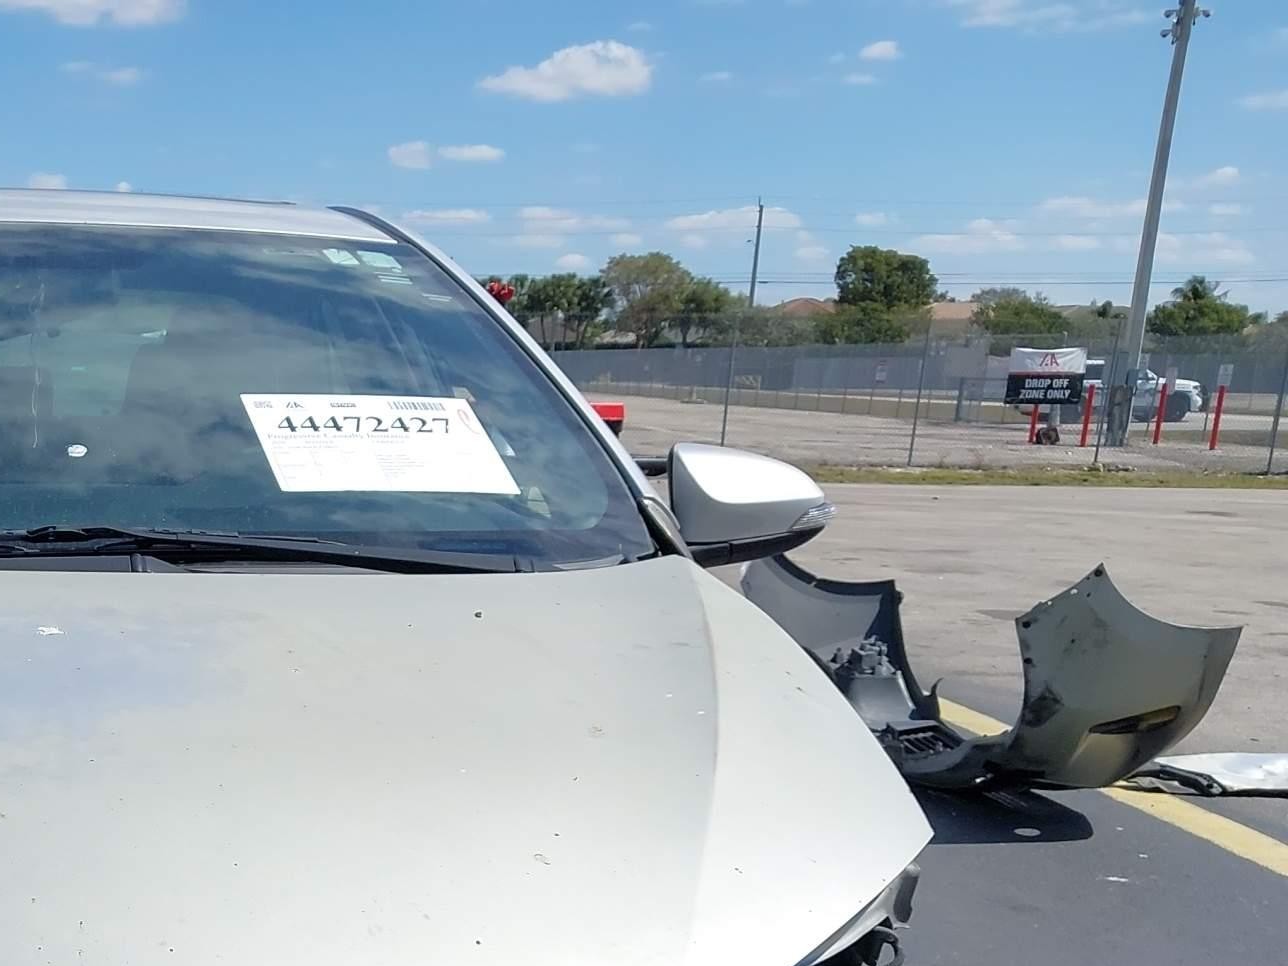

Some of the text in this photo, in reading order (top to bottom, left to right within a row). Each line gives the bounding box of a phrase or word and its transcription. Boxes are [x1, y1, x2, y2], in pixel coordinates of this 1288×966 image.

[1025, 378, 1070, 388] DROP OFF
[1019, 389, 1071, 399] ZONE ONLY
[278, 415, 449, 434] 44472427
